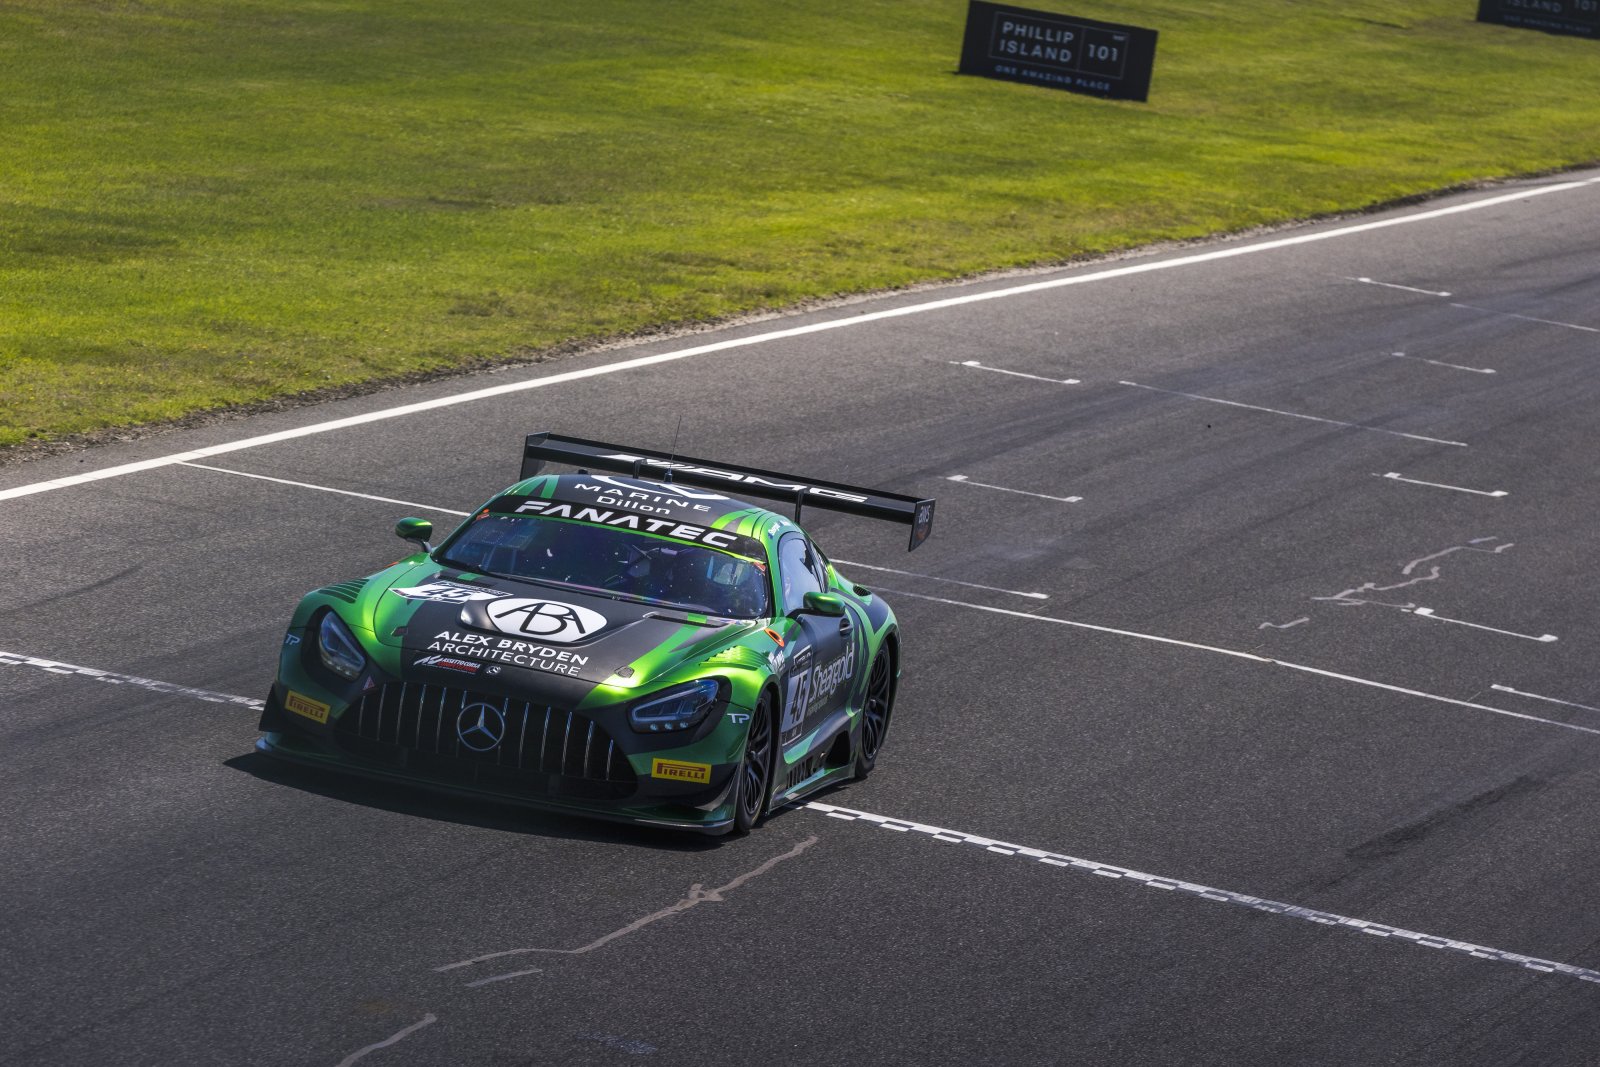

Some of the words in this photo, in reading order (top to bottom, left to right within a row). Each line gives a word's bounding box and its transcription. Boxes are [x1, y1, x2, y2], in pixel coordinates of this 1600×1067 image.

[1002, 21, 1074, 43] PHILLIP
[999, 39, 1072, 62] ISLAND
[1088, 44, 1118, 62] 101
[1076, 78, 1111, 91] PLACE
[574, 483, 711, 511] MARINE
[596, 495, 671, 515] Dillon
[514, 501, 738, 548] FANATEC
[427, 641, 581, 677] ARCHITECTURE
[434, 631, 493, 646] ALEX
[497, 639, 589, 666] BRYDEN
[808, 642, 855, 703] Sheargold
[289, 695, 325, 719] PIRELLI
[657, 762, 706, 780] PIRELLI
